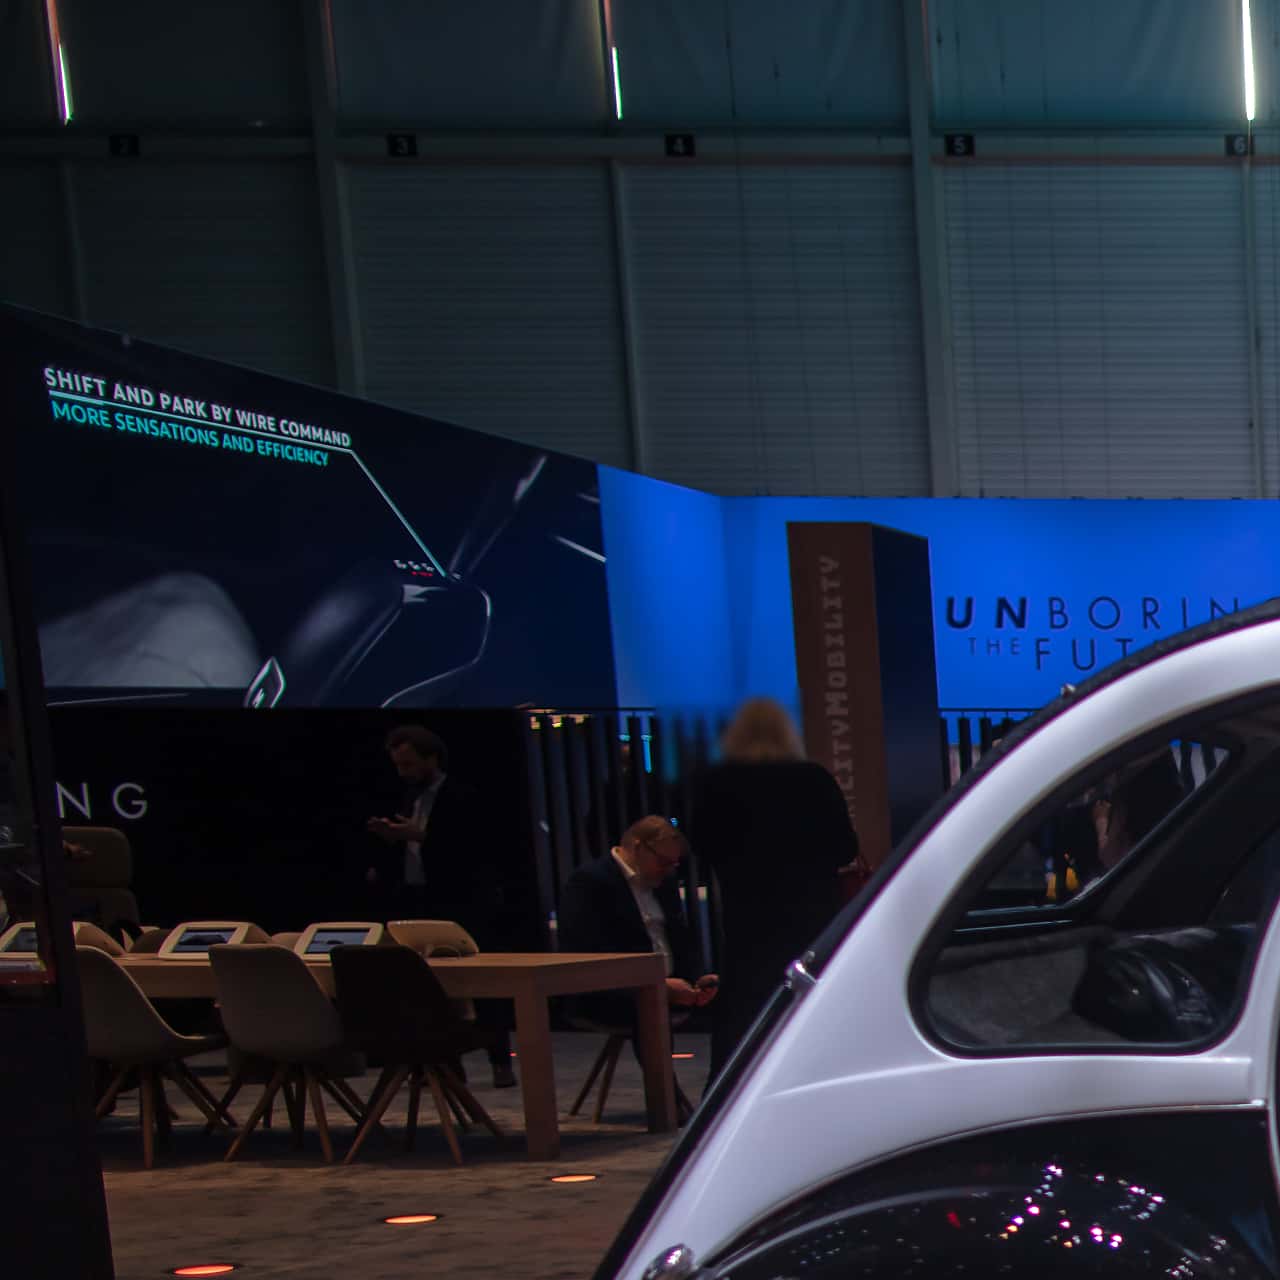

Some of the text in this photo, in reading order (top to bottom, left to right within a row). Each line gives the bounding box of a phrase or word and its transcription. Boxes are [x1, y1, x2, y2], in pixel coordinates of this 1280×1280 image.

[44, 366, 351, 447] SHIFT AND PARK BY WIRE COMMAND
[51, 400, 329, 466] MORE SENSATIONS AND EFFICIENCY
[945, 596, 1240, 630] UNBORIN
[968, 636, 1020, 655] THE
[819, 554, 856, 818] CITYMOBILITY
